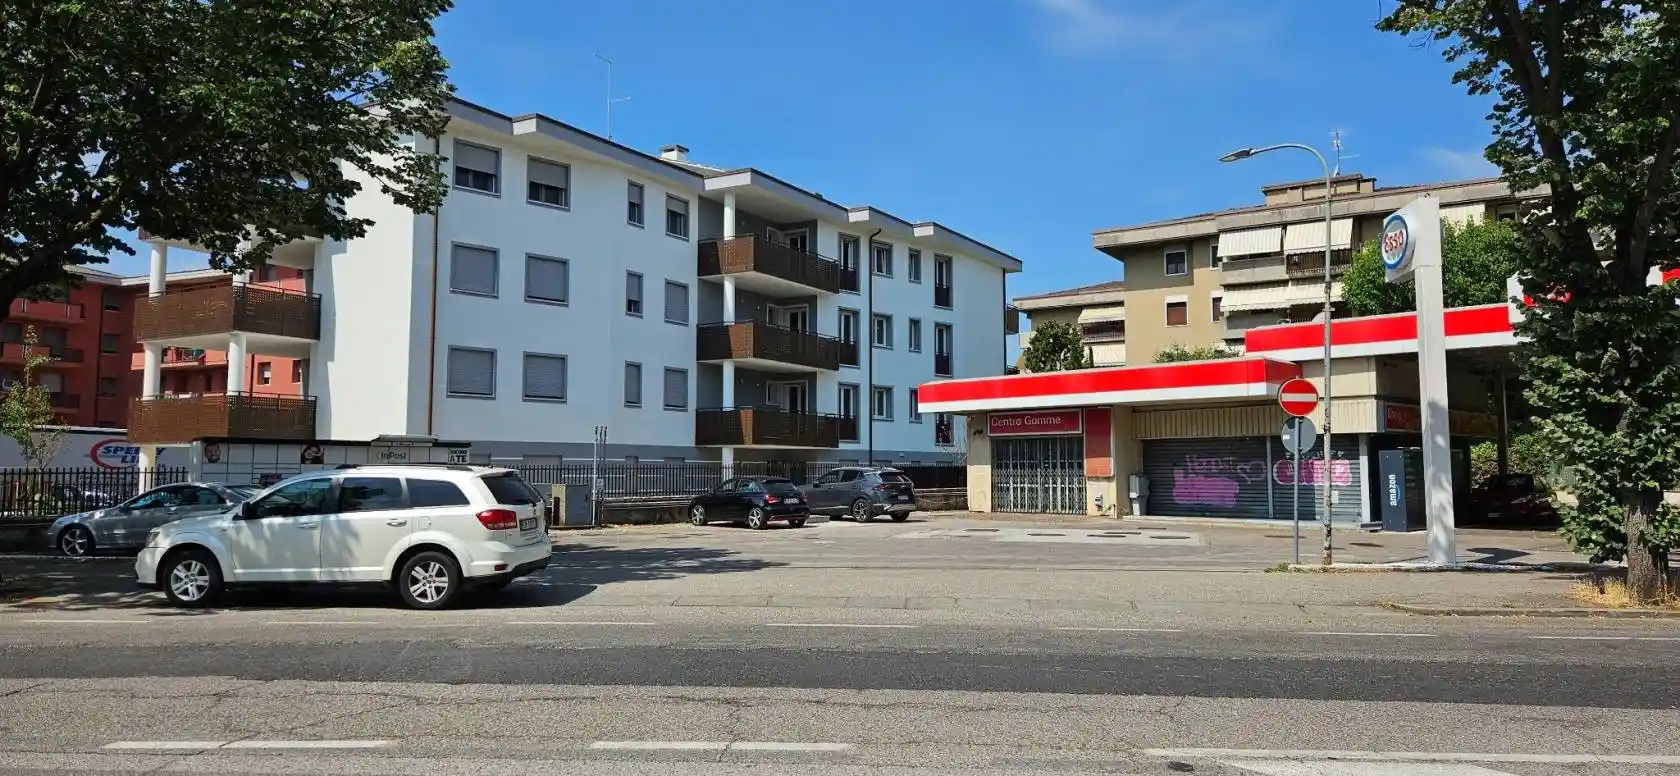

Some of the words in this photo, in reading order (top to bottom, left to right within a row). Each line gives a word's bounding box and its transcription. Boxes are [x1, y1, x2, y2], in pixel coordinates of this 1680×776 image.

[991, 416, 1022, 427] Centro
[1024, 415, 1061, 425] Gomme
[381, 451, 407, 460] InPost
[1389, 474, 1398, 506] amazon
